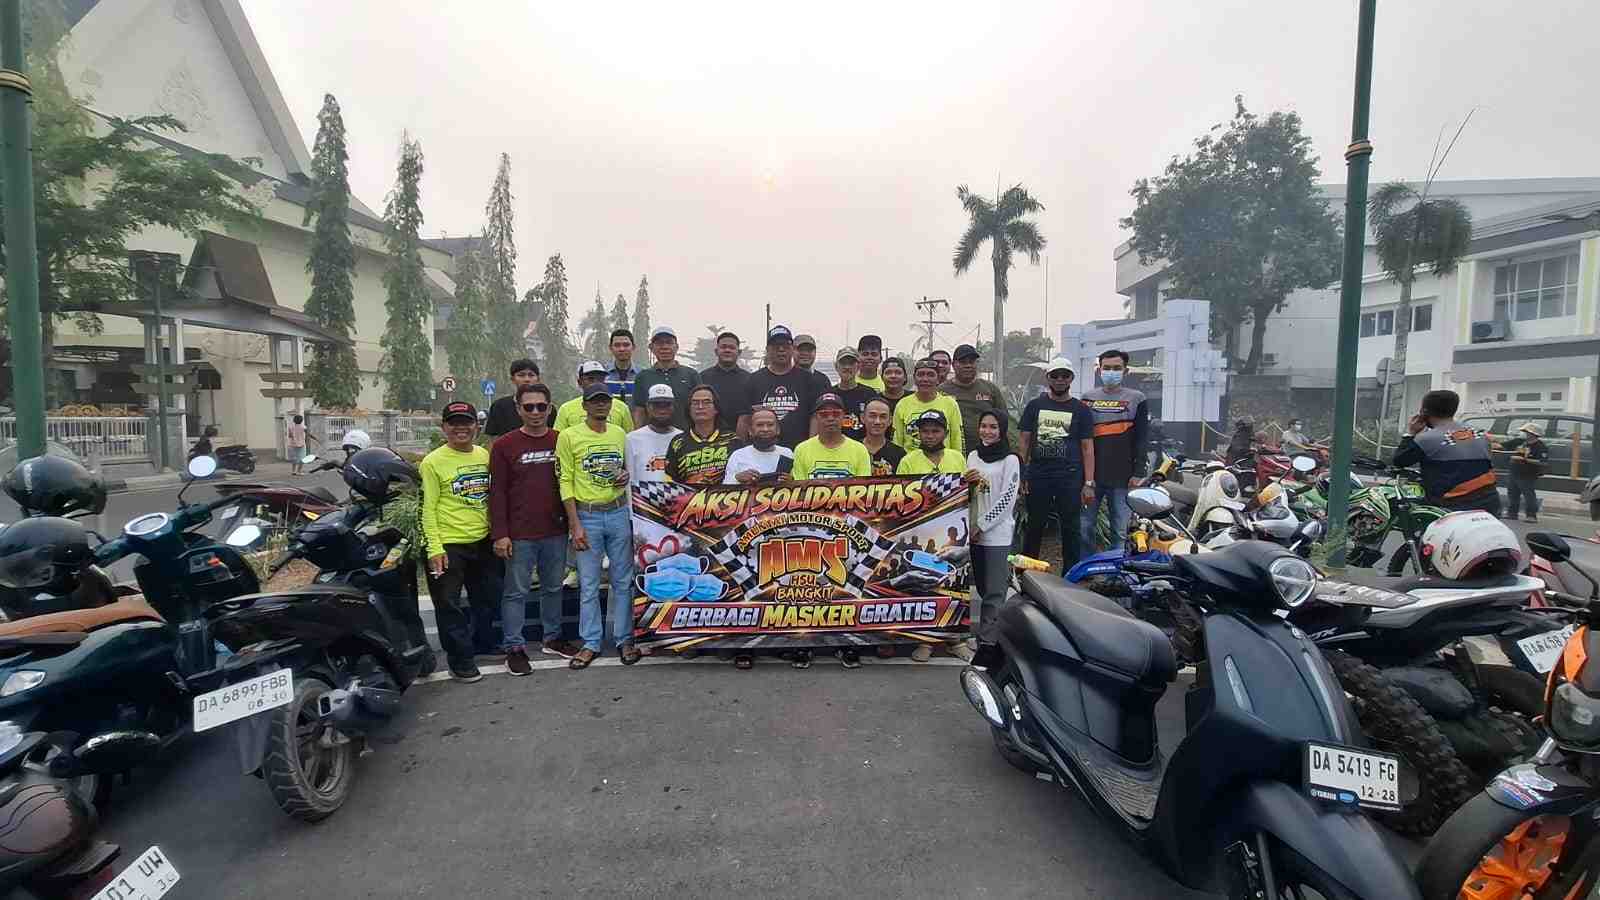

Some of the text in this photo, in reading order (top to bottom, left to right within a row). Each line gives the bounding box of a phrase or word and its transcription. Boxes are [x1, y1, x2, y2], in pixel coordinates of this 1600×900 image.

[678, 482, 924, 527] AKSI SOLIDARITAS
[789, 512, 832, 527] MOTOR
[833, 515, 868, 550] SPORT
[759, 537, 848, 586] AMS
[776, 586, 833, 600] BANGKIT
[790, 574, 816, 586] HSU
[672, 601, 937, 628] BERBAGI MASKER GRATIS
[198, 674, 288, 712] DA 6899 FBB
[1313, 749, 1395, 781] DA 5419 FG
[138, 850, 164, 877] UW
